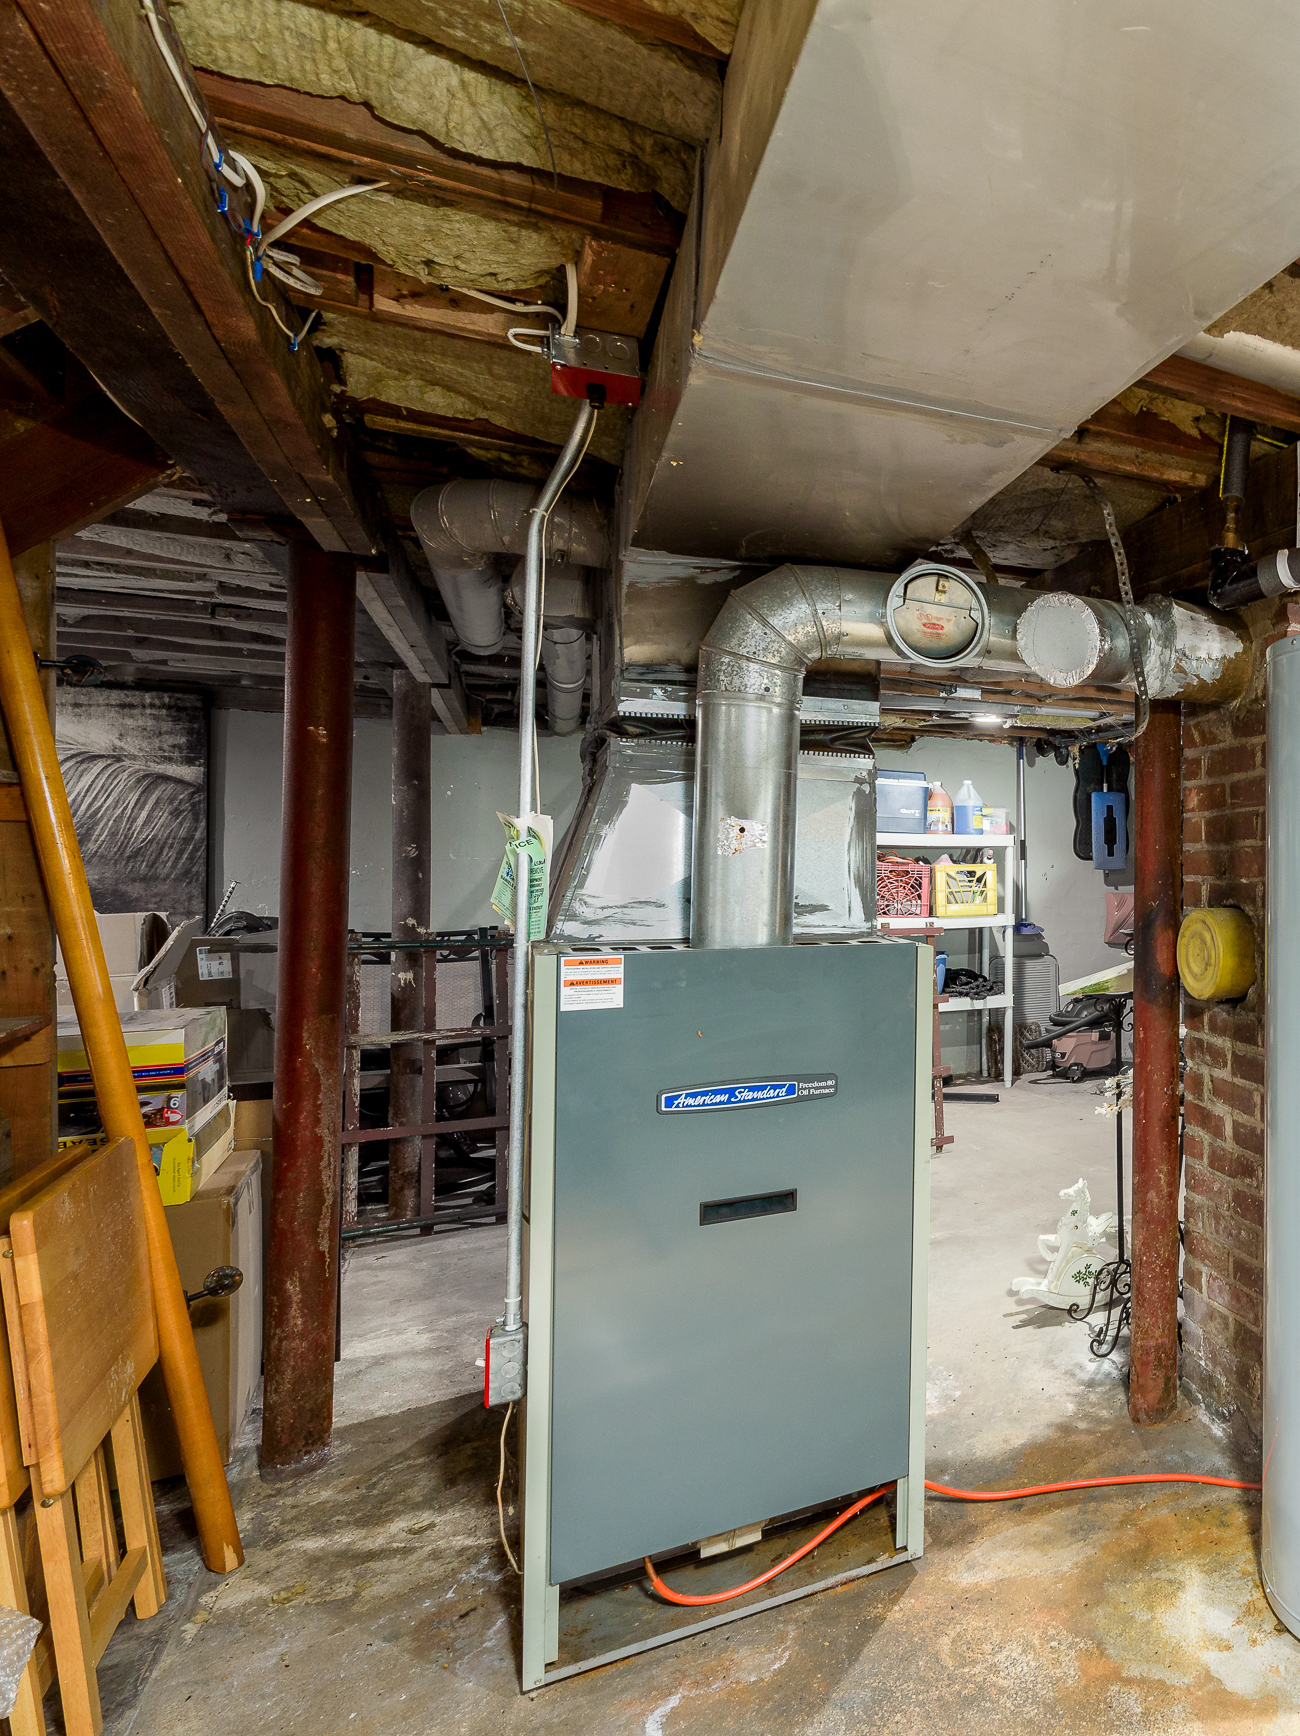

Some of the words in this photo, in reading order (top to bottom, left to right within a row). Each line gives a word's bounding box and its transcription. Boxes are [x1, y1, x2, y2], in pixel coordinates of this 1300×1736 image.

[799, 1081, 826, 1089] Freedom
[809, 1087, 835, 1095] Furnace
[672, 1092, 729, 1109] American
[731, 1083, 790, 1102] Standard
